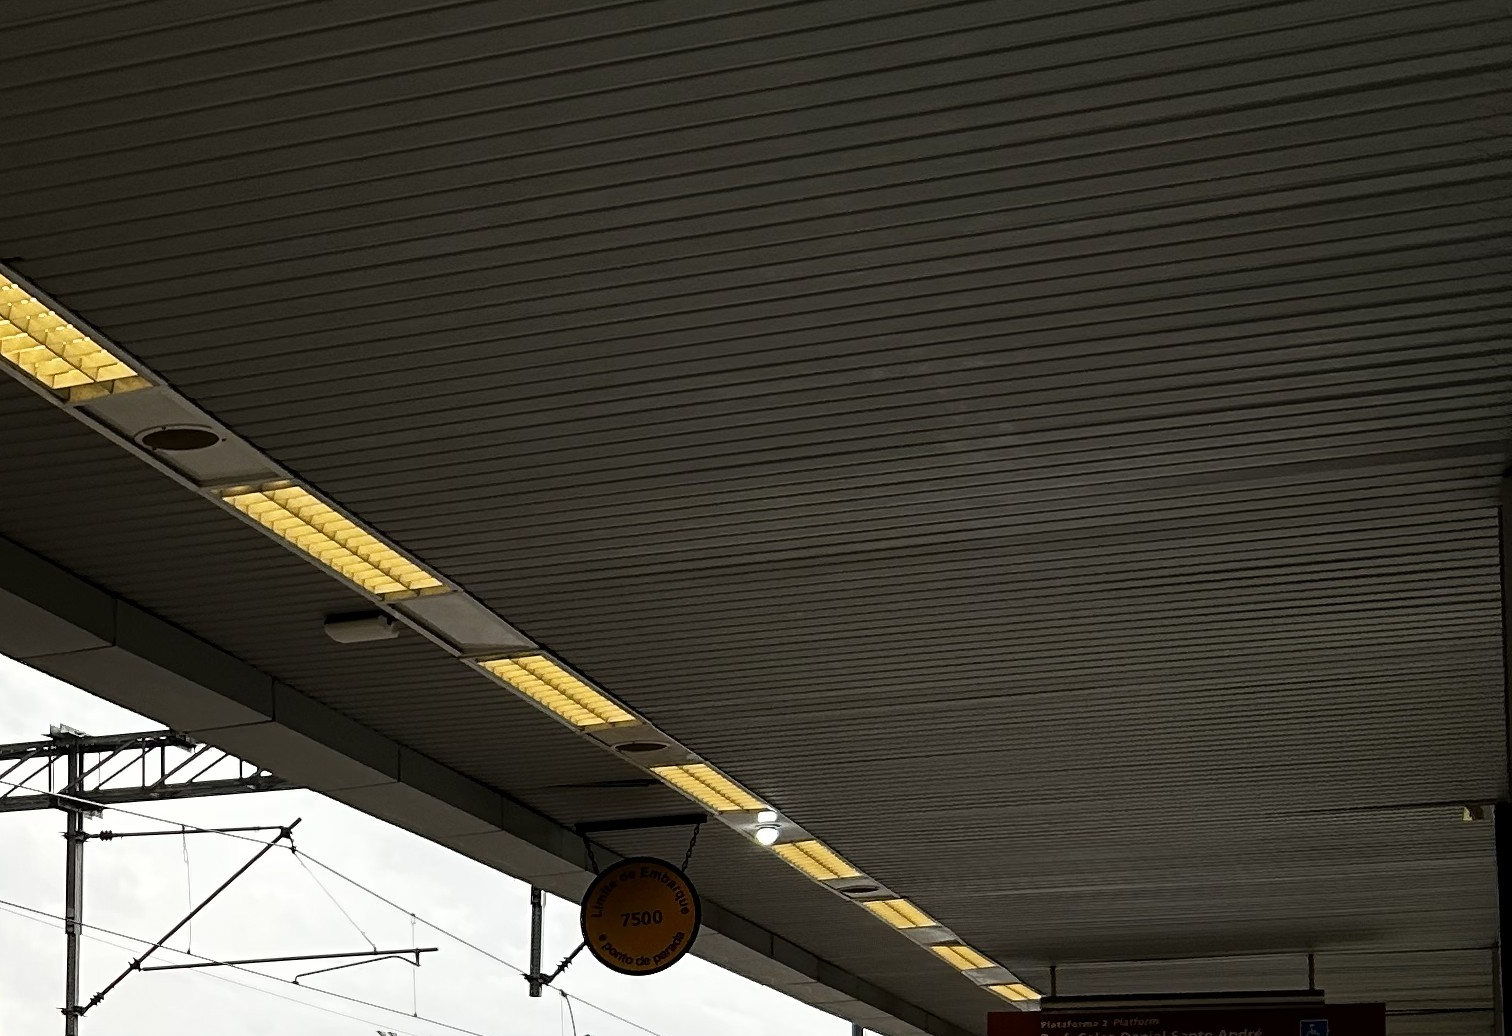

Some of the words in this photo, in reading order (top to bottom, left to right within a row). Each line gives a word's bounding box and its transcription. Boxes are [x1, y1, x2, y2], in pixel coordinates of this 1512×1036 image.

[591, 880, 617, 918] Limite
[619, 869, 636, 882] de
[640, 866, 690, 915] Embarque
[620, 909, 663, 928] 7500
[602, 941, 634, 965] ponto
[635, 955, 650, 966] de
[653, 931, 685, 965] parada
